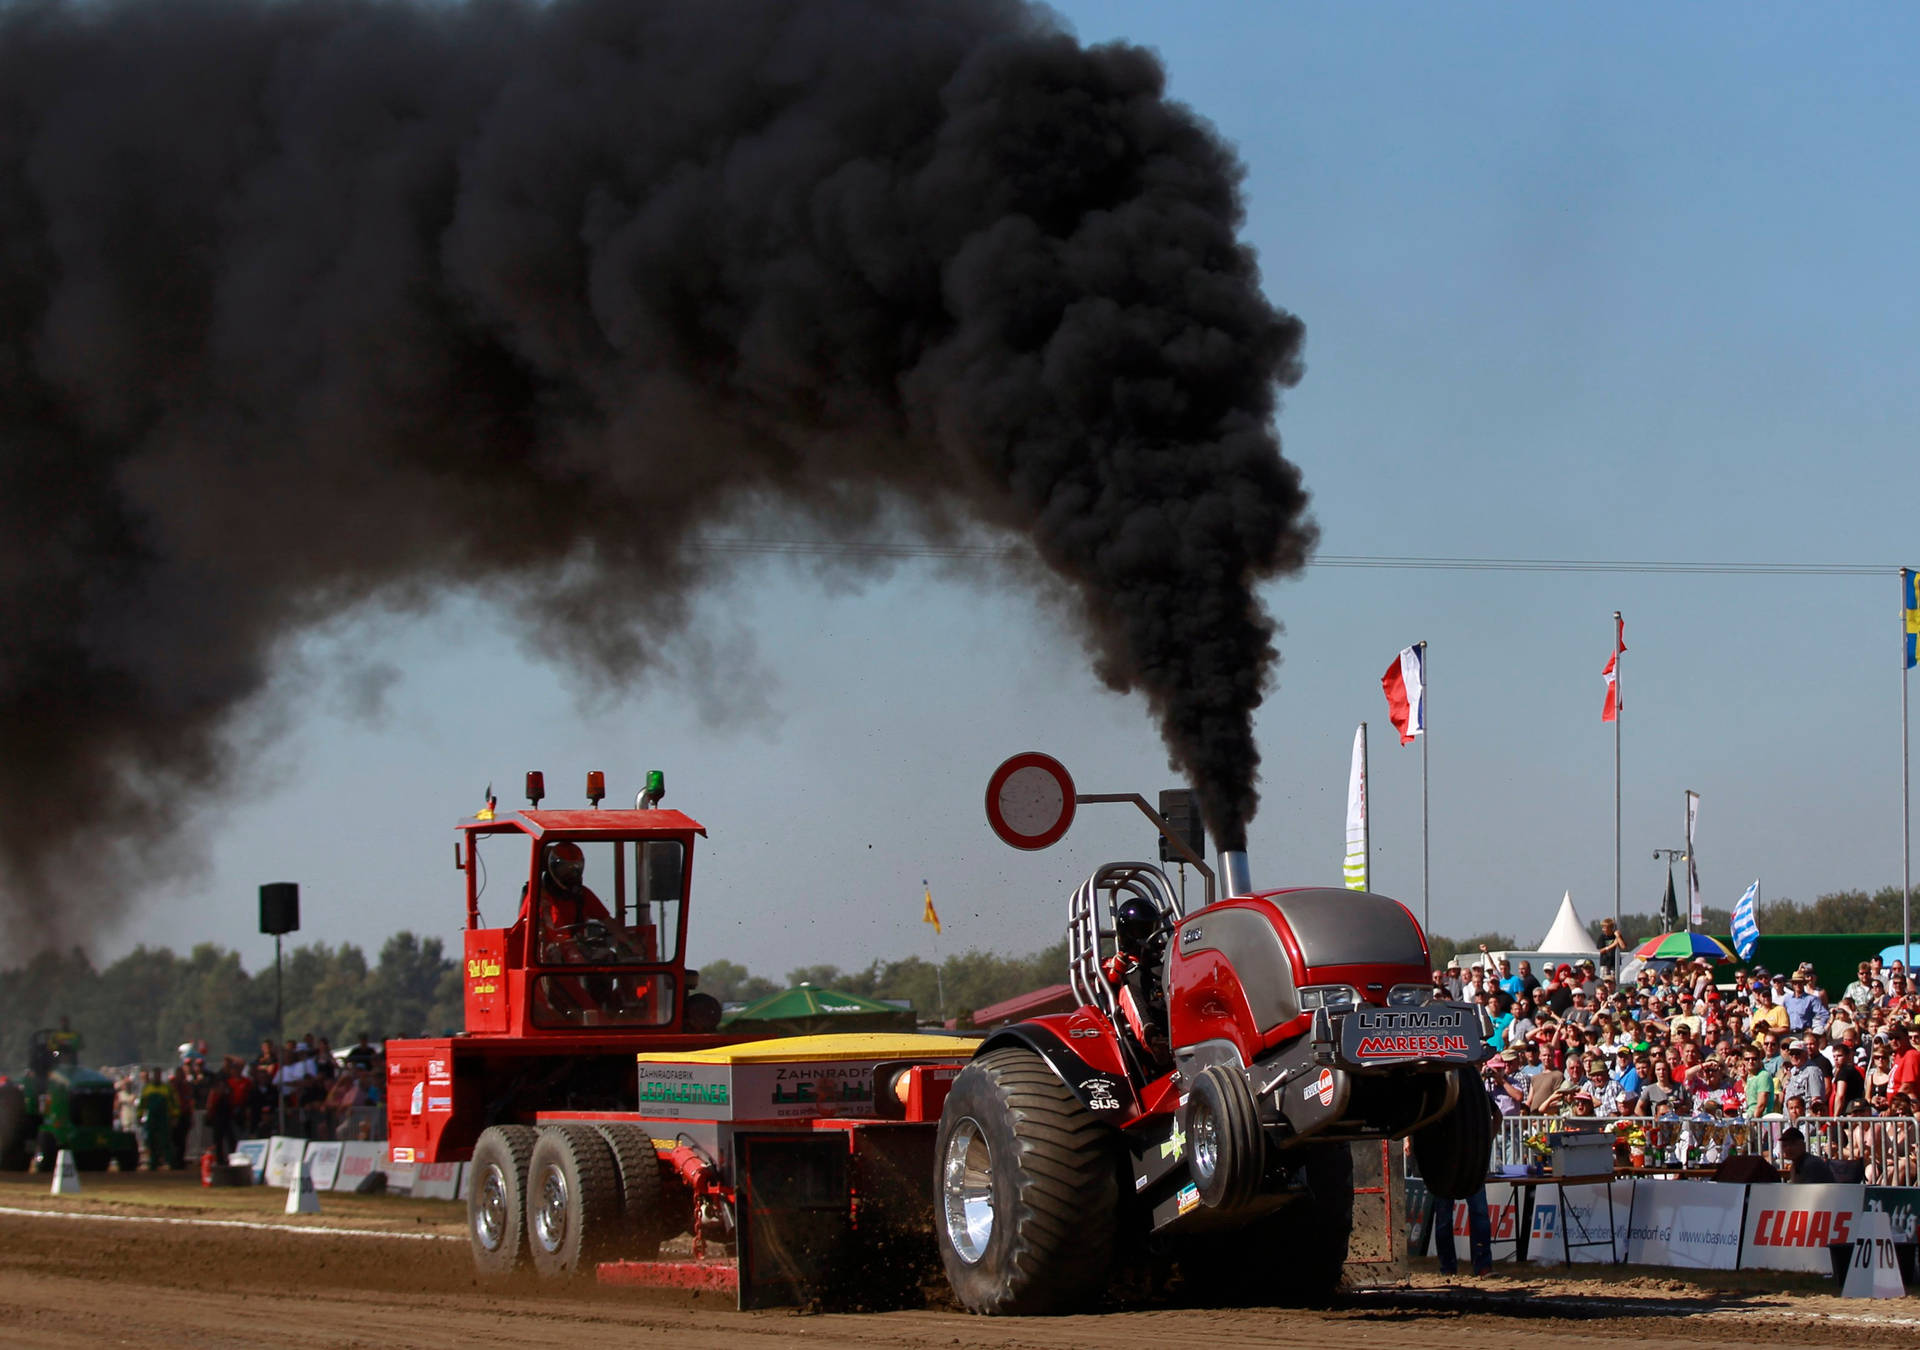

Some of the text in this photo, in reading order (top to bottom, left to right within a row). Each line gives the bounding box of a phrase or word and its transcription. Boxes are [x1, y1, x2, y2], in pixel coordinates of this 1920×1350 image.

[1359, 1011, 1461, 1029] LiTiM.nl
[1357, 1036, 1468, 1057] MAREES.NL
[640, 1068, 693, 1079] ZAHNRADFABRIK
[1089, 1099, 1120, 1110] SIJS
[1679, 1229, 1738, 1246] www.vbasw.de
[1753, 1210, 1853, 1248] CLAAS
[1854, 1238, 1872, 1269] 70
[1875, 1238, 1895, 1269] 70
